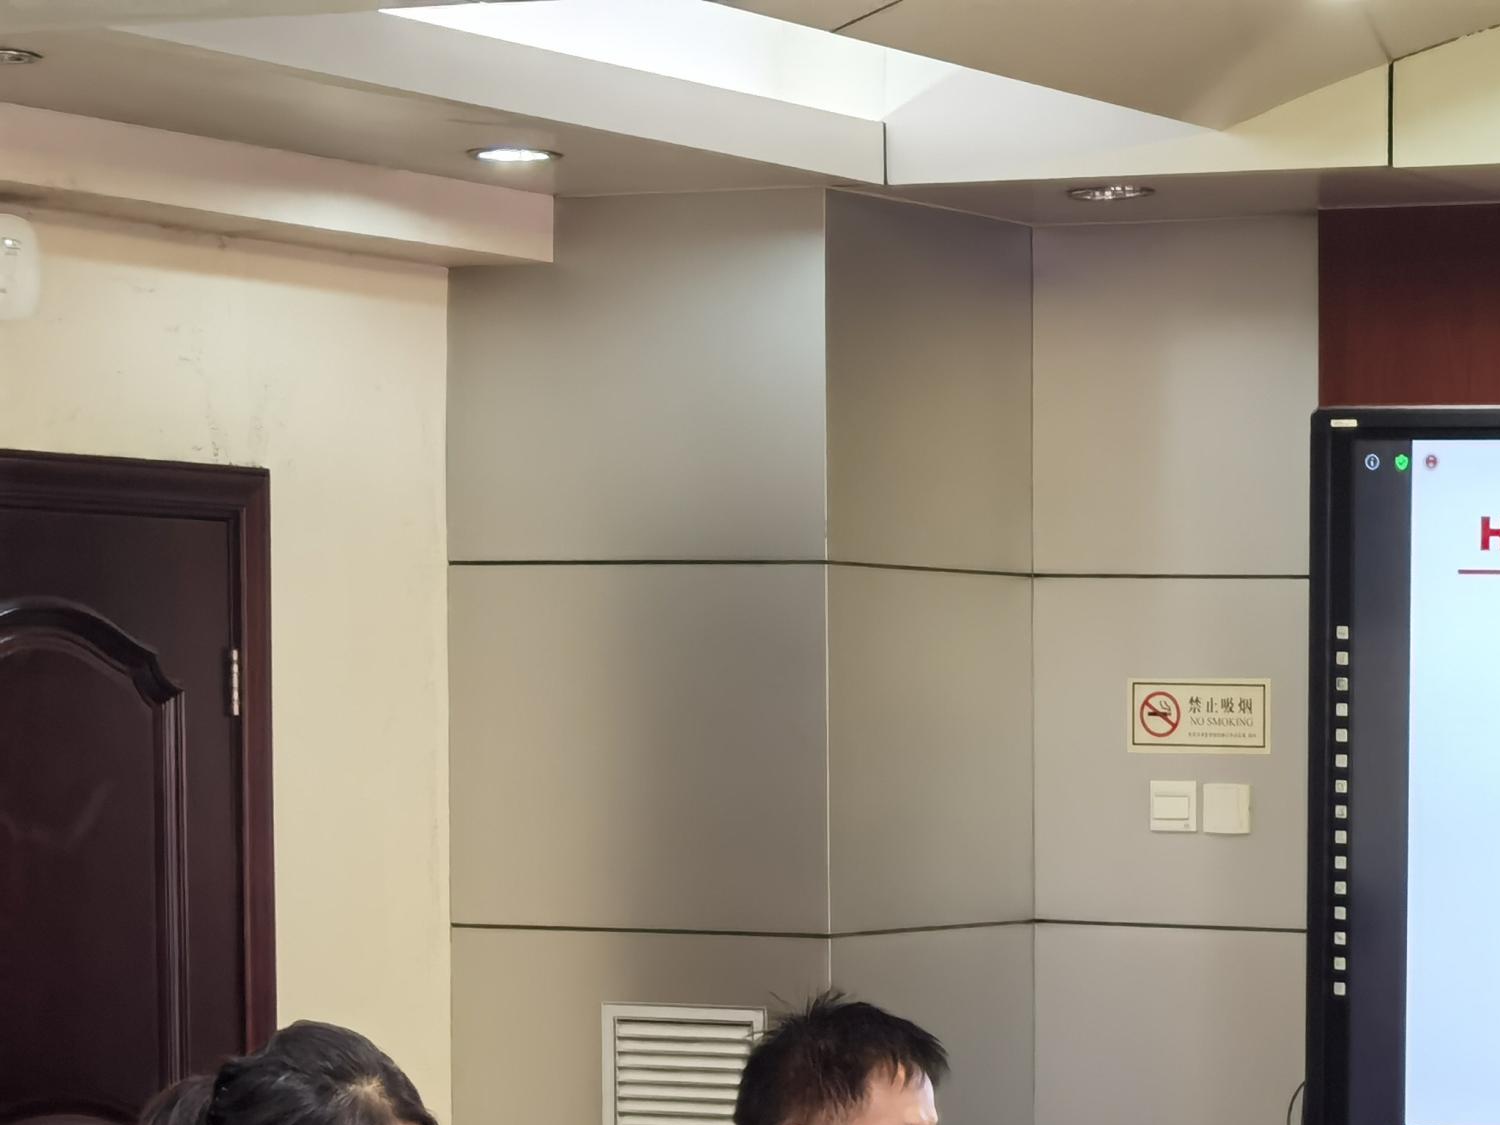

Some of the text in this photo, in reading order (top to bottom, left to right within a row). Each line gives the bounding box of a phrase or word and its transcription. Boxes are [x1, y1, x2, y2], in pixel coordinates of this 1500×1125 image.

[1188, 696, 1253, 714] 禁止吸烟
[1190, 716, 1254, 727] NO SMOKING
